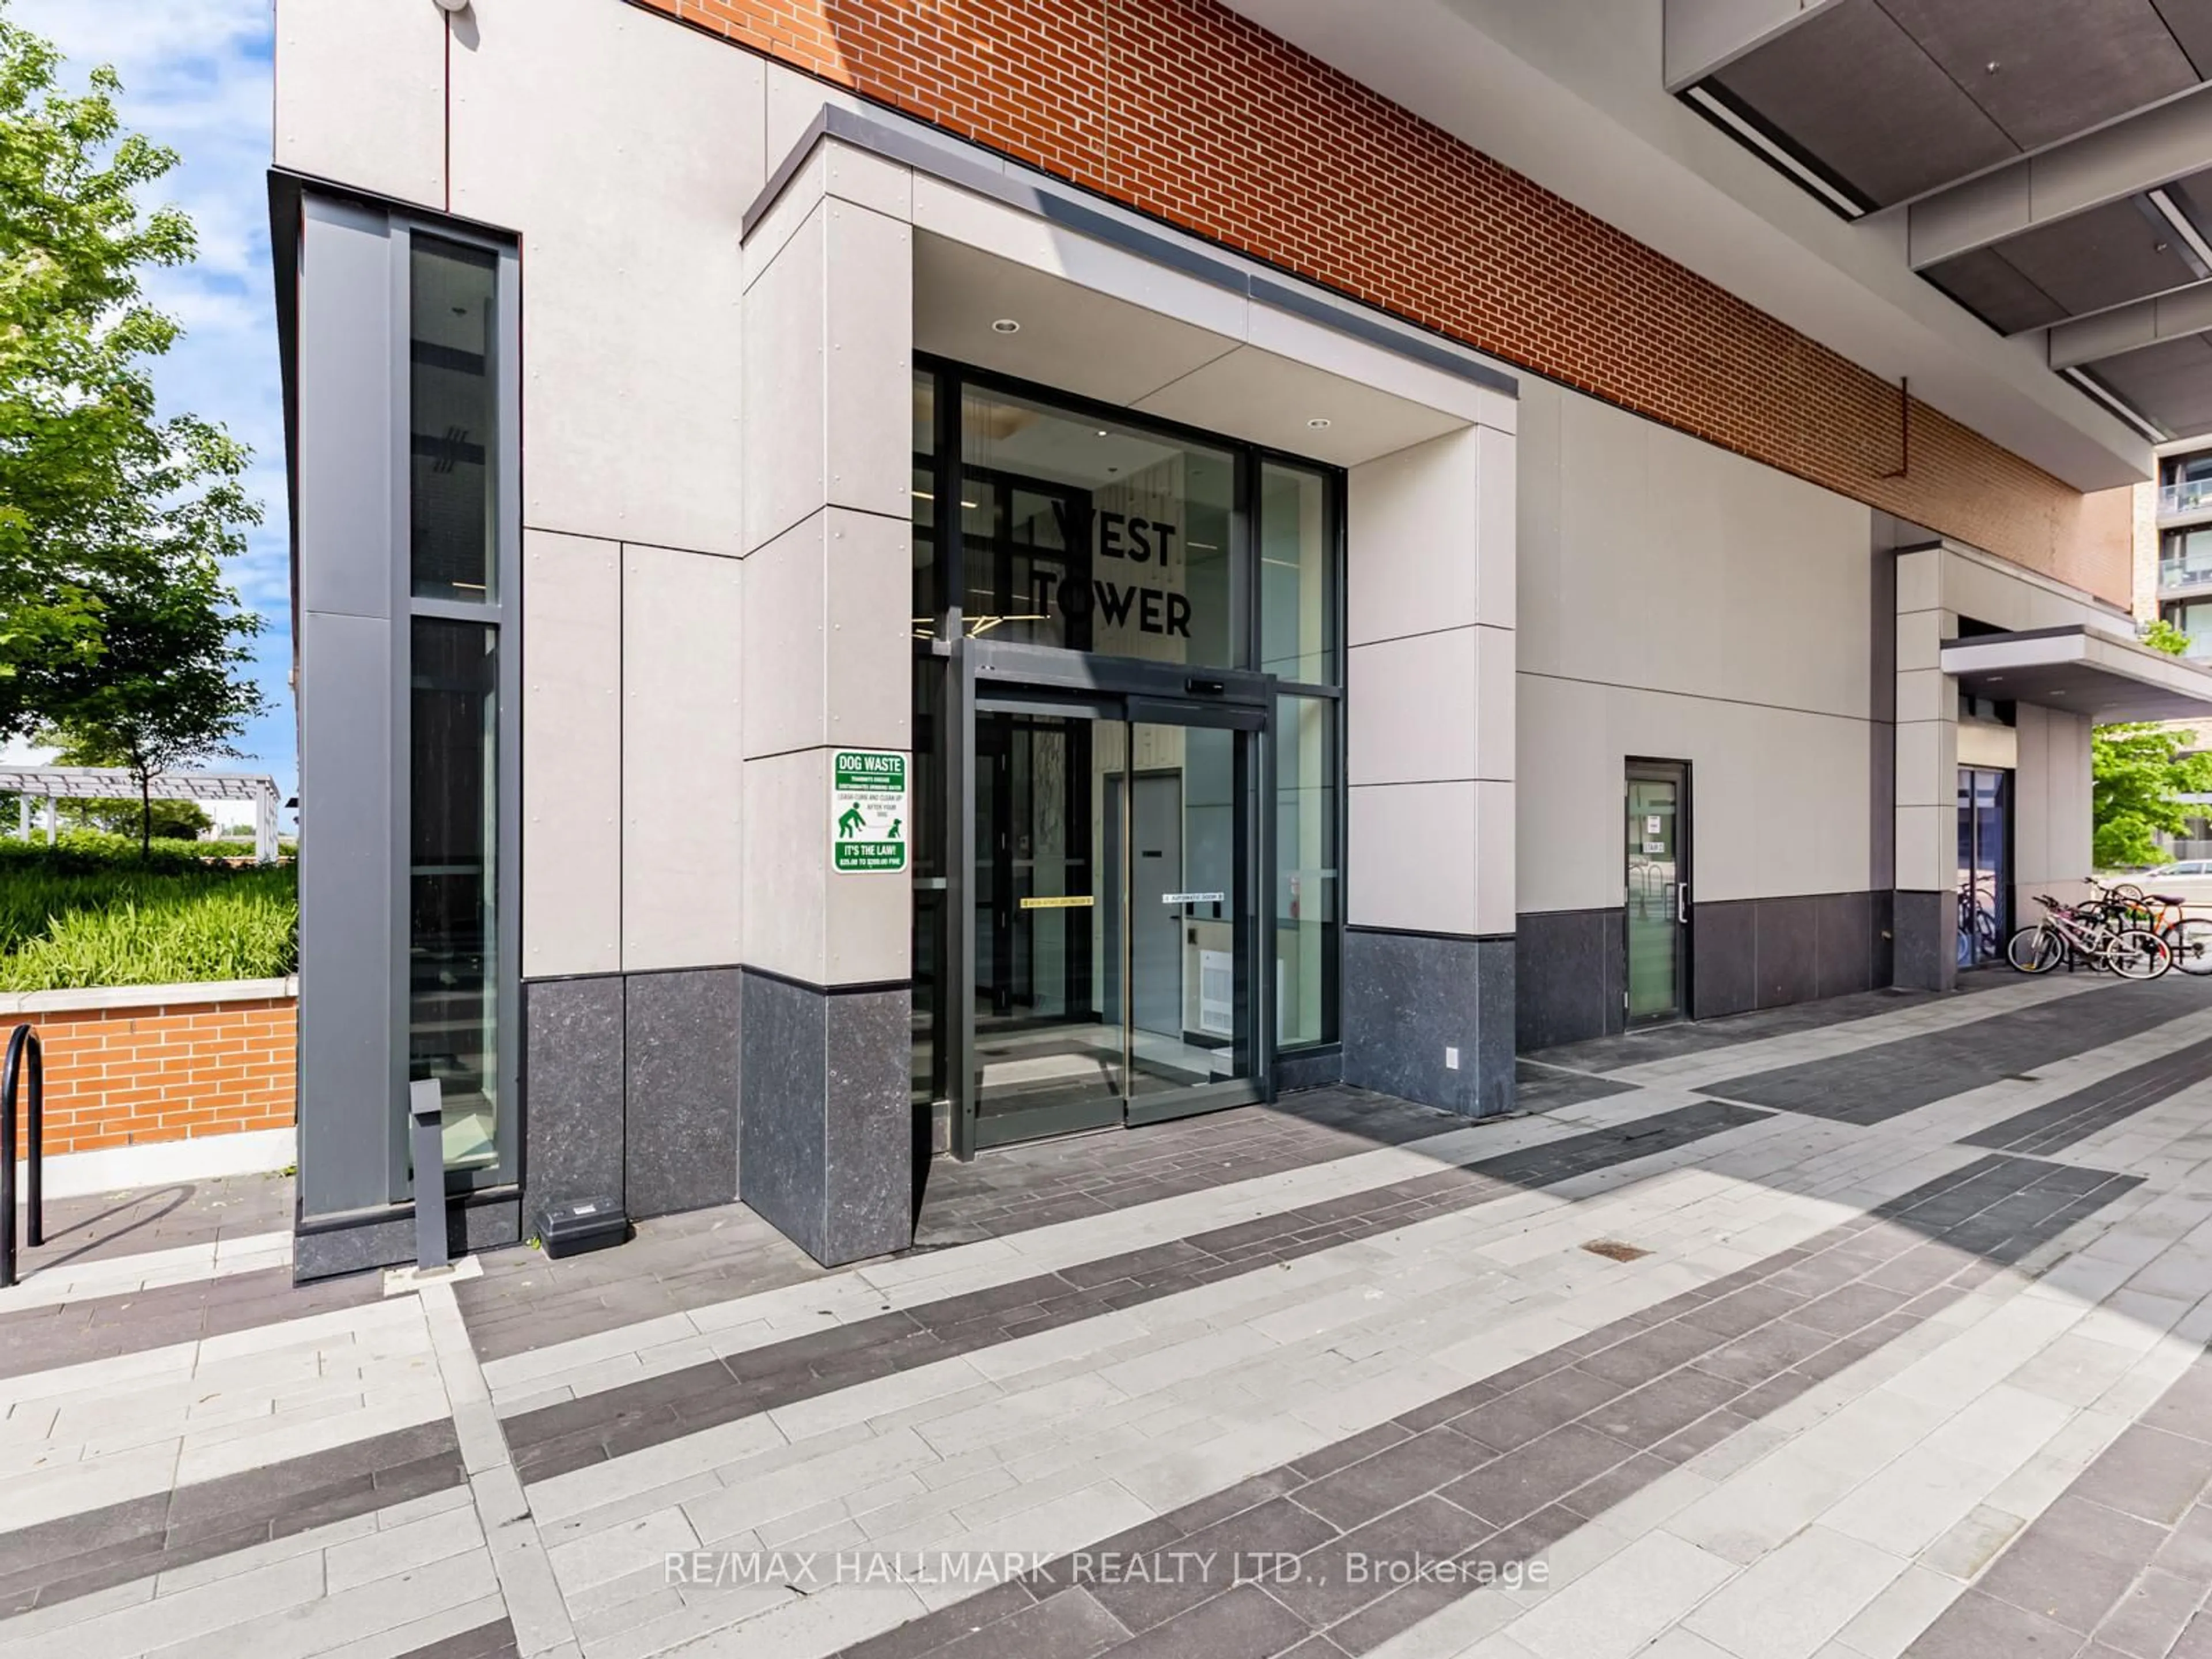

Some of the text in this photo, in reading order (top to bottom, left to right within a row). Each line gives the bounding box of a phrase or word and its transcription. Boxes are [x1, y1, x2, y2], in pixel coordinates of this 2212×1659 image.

[1030, 570, 1191, 638] TOWER
[839, 756, 901, 771] DOG WASTE
[844, 845, 896, 855] IT'S THE LAW!
